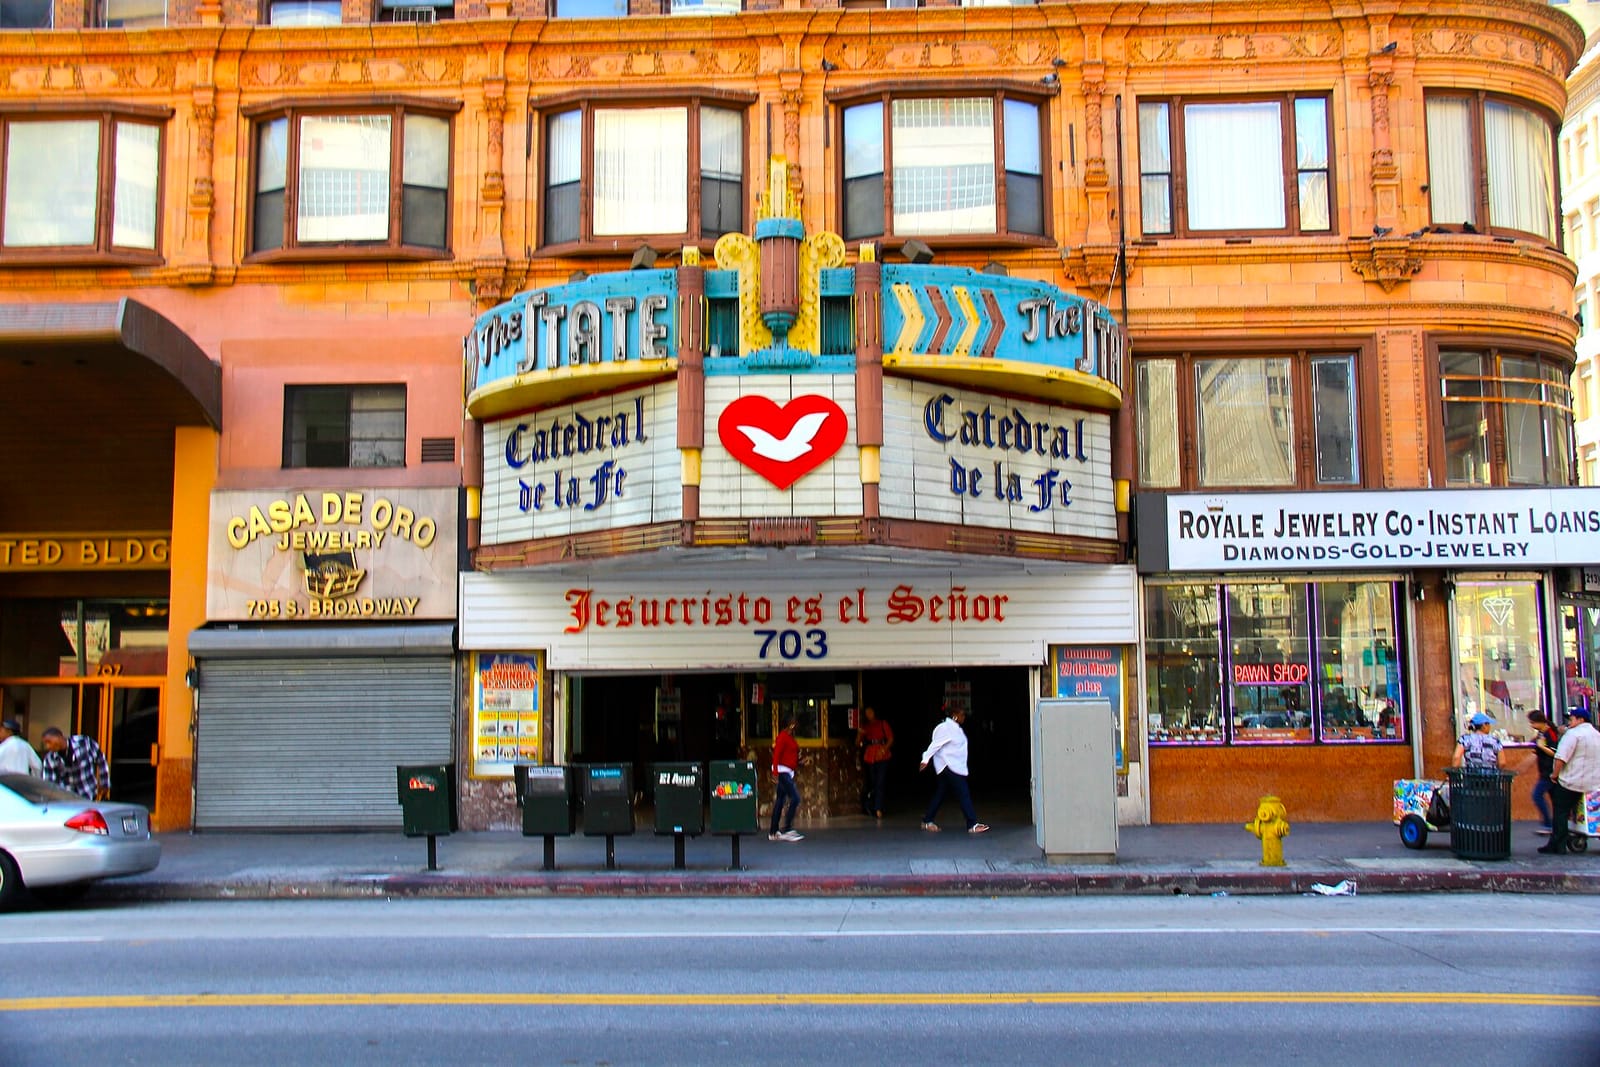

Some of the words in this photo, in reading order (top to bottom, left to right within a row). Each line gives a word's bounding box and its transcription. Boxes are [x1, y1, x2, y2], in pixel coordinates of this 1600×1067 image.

[481, 312, 522, 367] The
[517, 292, 667, 374] STATE
[1018, 297, 1081, 342] The
[505, 396, 648, 468] Catedral
[924, 394, 1088, 462] Catedral
[519, 477, 546, 511] de
[553, 471, 580, 507] la
[584, 461, 627, 511] Fe
[950, 457, 983, 497] de
[994, 461, 1023, 501] la
[1028, 469, 1073, 512] Fe
[227, 493, 316, 549] CASA
[322, 492, 363, 524] DE
[370, 498, 436, 548] ORO
[277, 530, 386, 550] JEWELRY
[0, 539, 63, 565] TED
[81, 538, 169, 564] BLDG
[247, 600, 280, 617] 705
[286, 600, 304, 616] S.
[309, 597, 420, 616] BROADWAY
[564, 589, 772, 634] Jesucristo
[786, 592, 824, 625] es
[838, 587, 869, 623] el
[886, 584, 1009, 624] Señor
[754, 629, 828, 659] 703
[1088, 662, 1117, 677] Mayo
[1234, 664, 1270, 682] PAWN
[1273, 663, 1308, 682] SHOP
